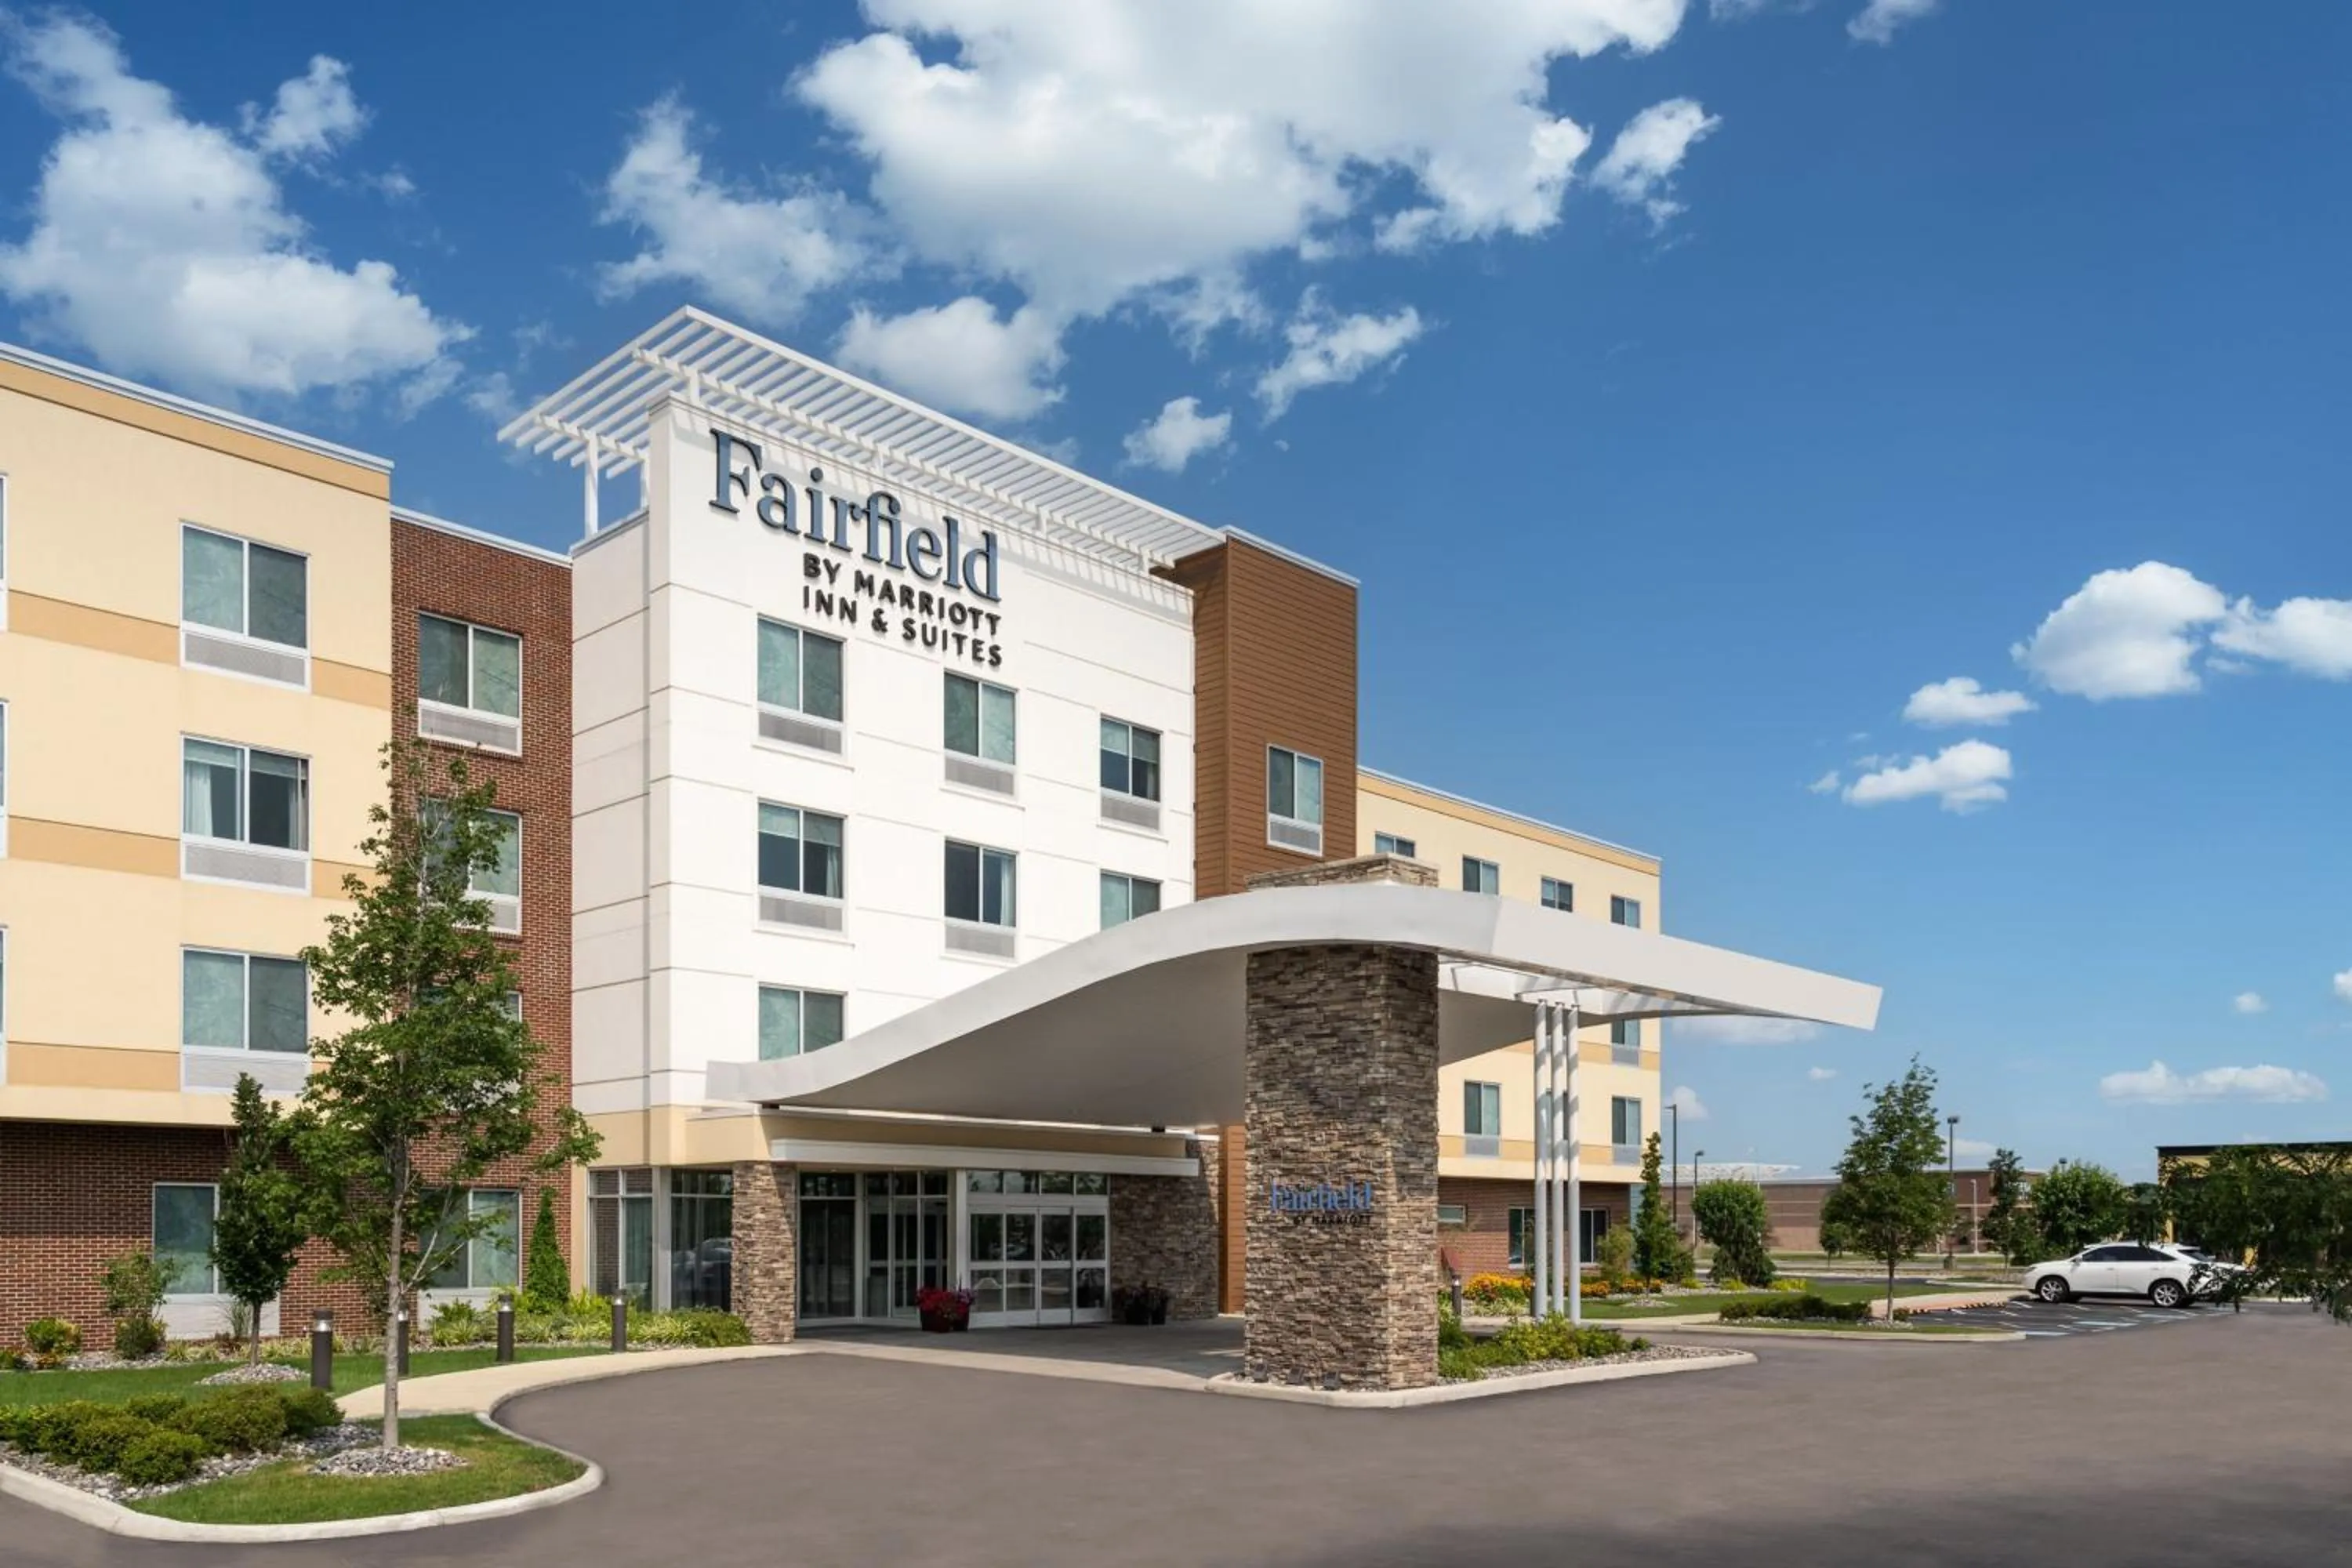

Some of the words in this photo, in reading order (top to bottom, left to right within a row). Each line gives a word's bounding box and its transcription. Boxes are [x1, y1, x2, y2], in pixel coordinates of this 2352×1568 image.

[709, 427, 1002, 603] Fairfield
[802, 584, 858, 624] INN
[871, 608, 888, 633] &
[902, 617, 1003, 667] SUITES
[803, 552, 841, 585] BY
[854, 569, 1002, 636] MARRIOTT
[1271, 1178, 1372, 1210] Fairfield
